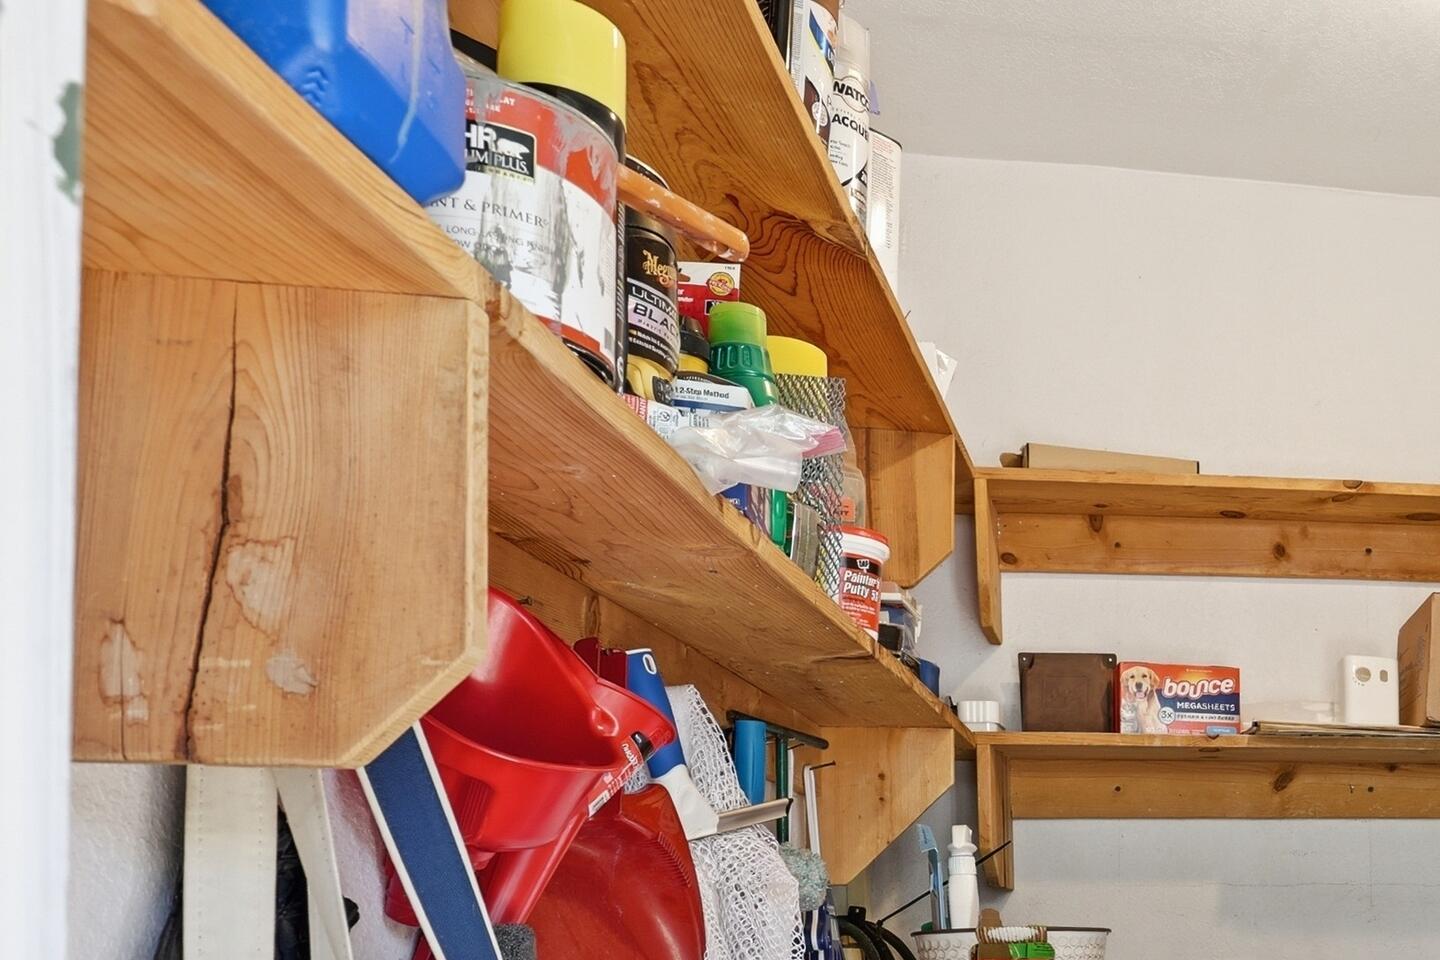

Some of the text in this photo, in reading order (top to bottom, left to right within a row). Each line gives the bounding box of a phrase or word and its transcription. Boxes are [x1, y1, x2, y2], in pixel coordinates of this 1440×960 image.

[465, 124, 498, 152] HR
[495, 155, 528, 175] PLUS
[463, 199, 477, 211] &
[482, 202, 545, 228] PRIMER
[446, 225, 476, 236] LONG
[633, 302, 678, 336] BLAC
[843, 582, 870, 599] Putty
[1162, 676, 1235, 699] bounce
[1176, 701, 1236, 712] MEGASHEETS
